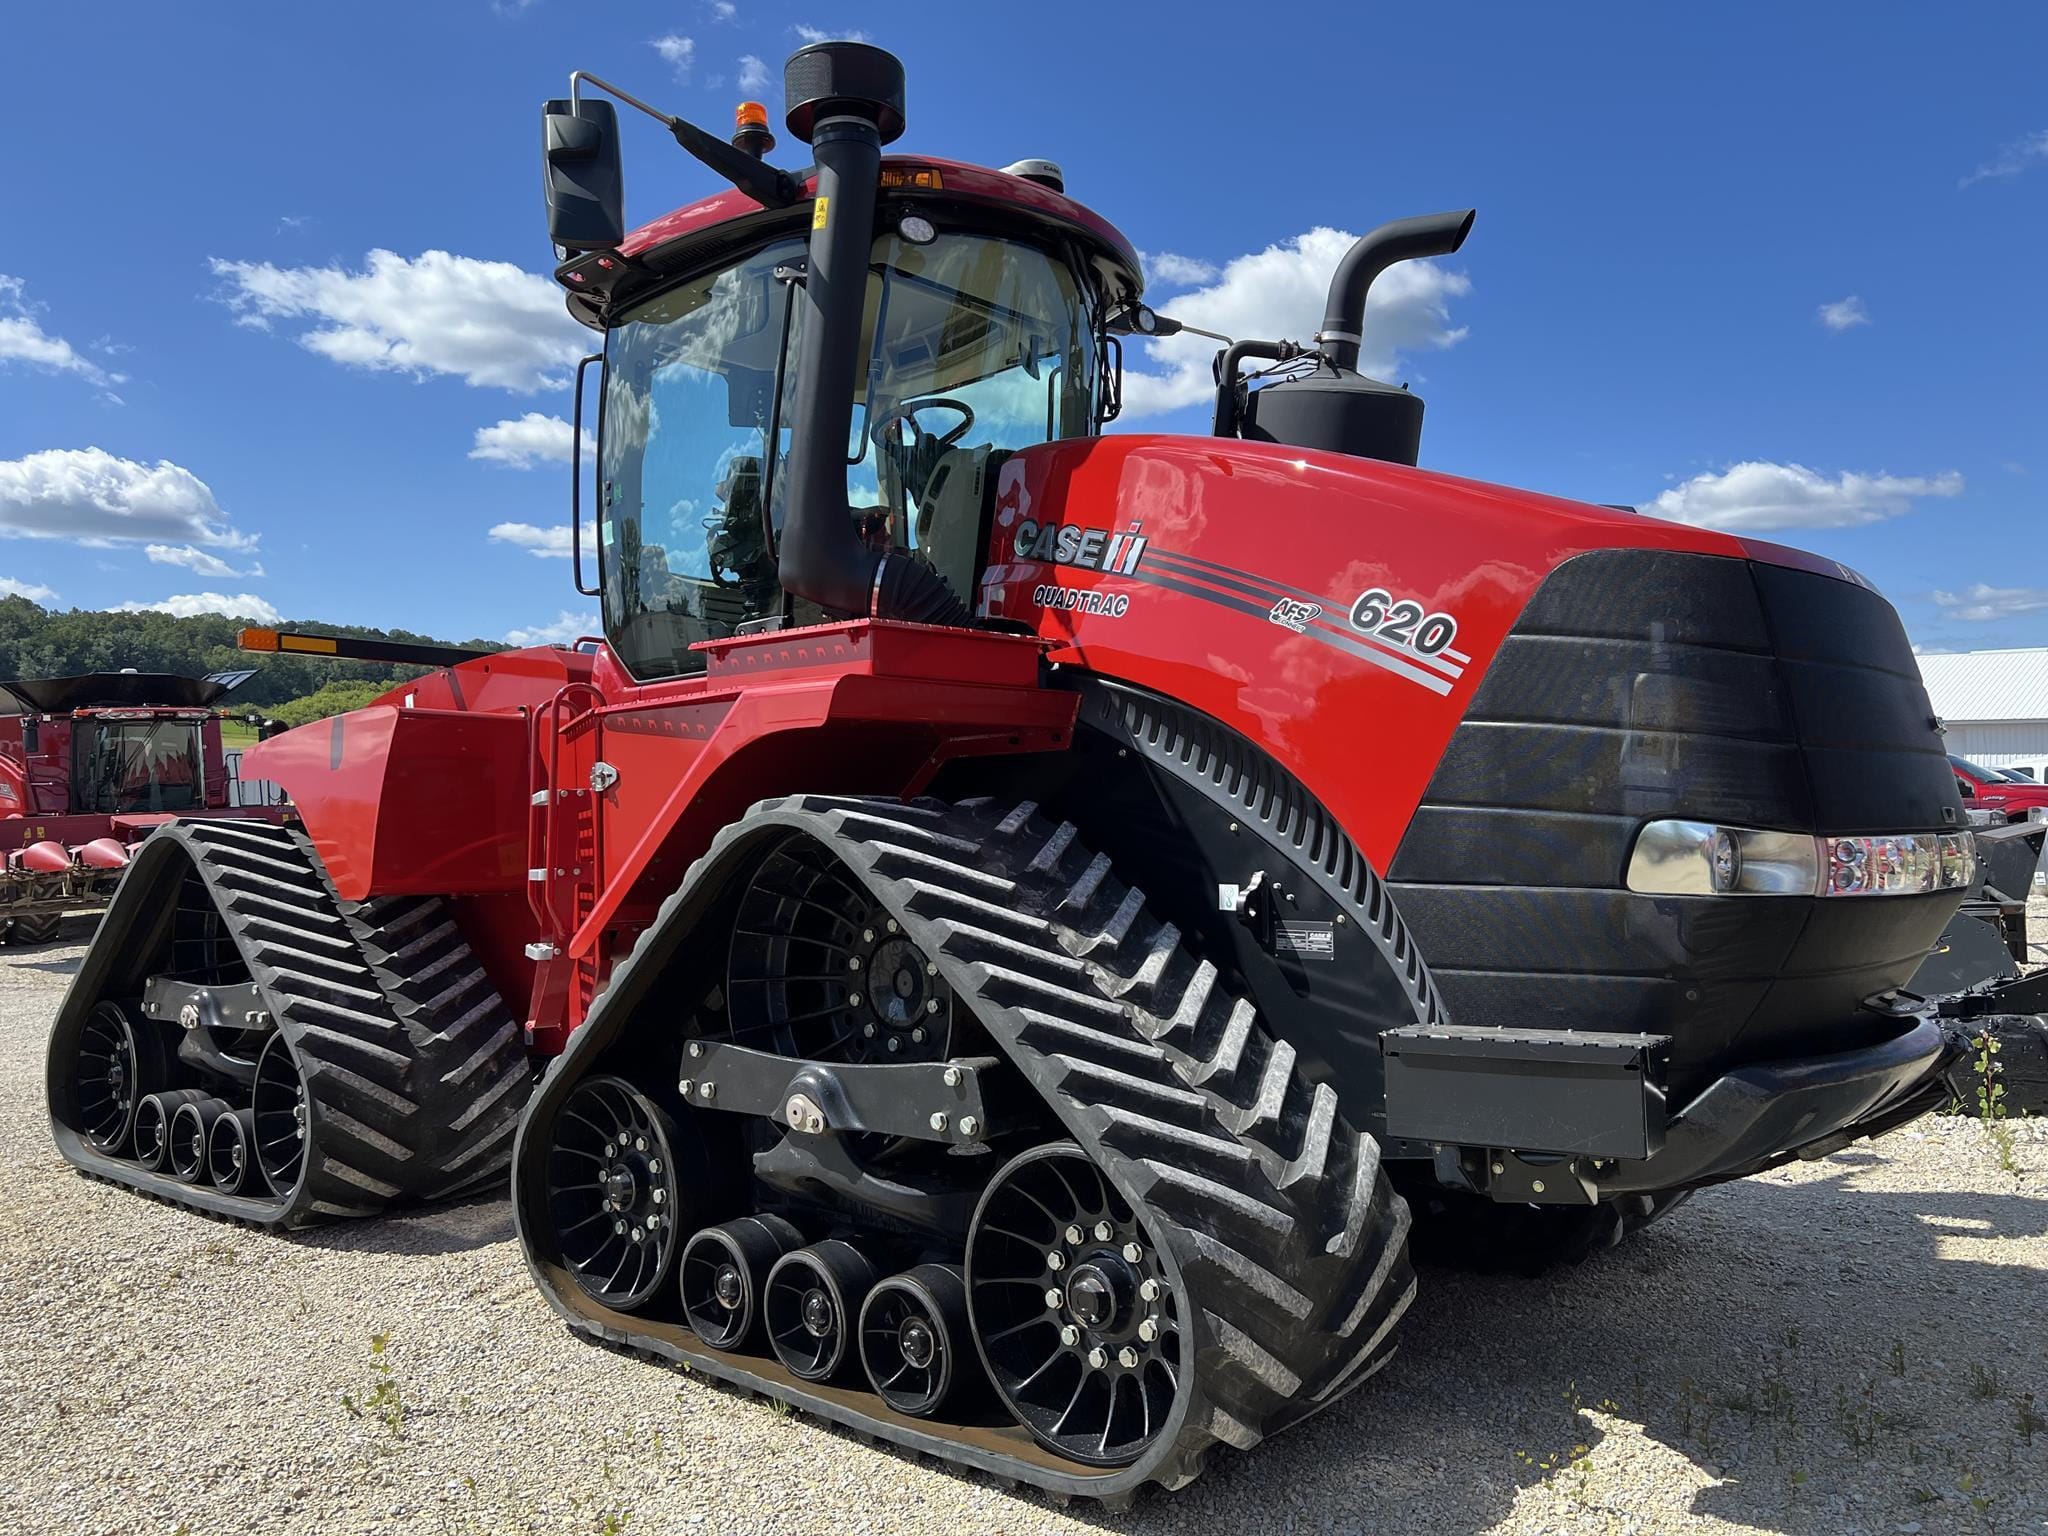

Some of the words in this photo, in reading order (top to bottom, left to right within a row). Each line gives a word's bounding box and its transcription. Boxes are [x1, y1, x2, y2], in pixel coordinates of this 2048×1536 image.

[1013, 519, 1108, 569] CASE
[1033, 584, 1129, 618] QUADTRAC
[1271, 598, 1311, 622] AFS
[1350, 588, 1457, 657] 620
